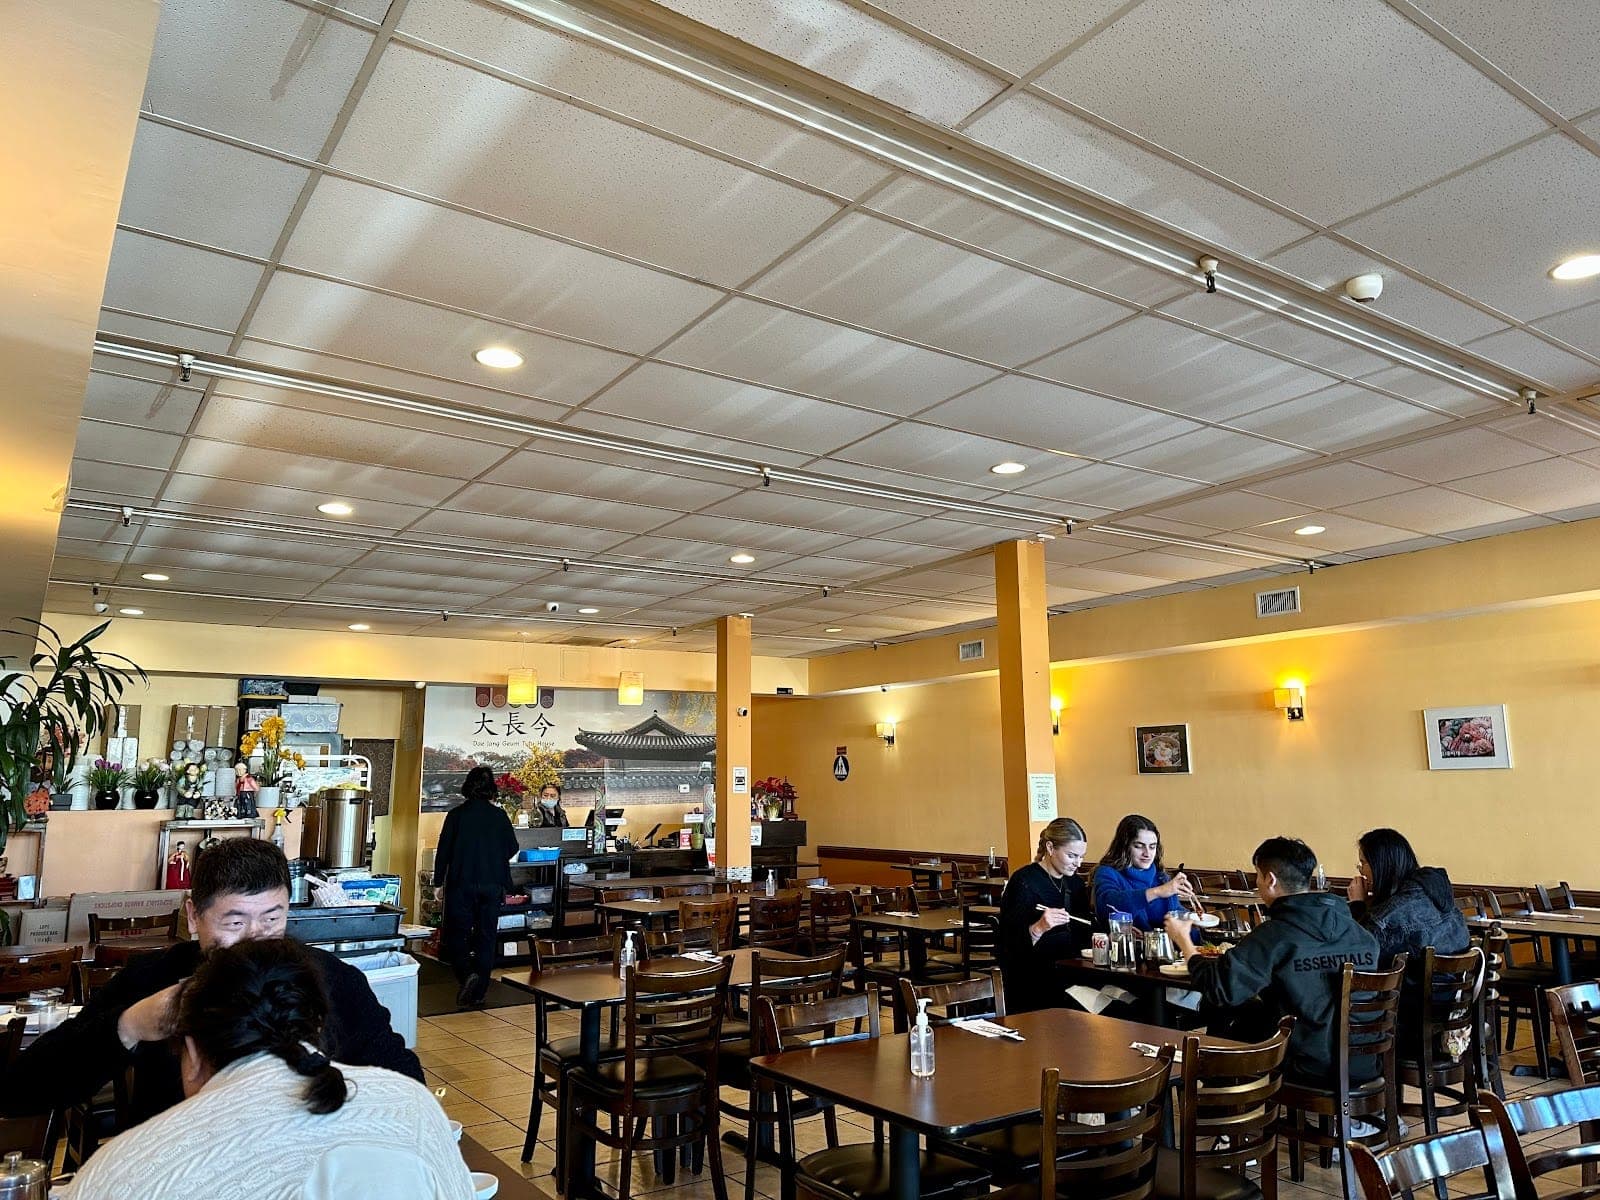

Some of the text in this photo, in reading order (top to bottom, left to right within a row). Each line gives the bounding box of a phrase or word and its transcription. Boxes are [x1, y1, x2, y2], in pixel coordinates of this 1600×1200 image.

[472, 711, 556, 738] 大長今
[1293, 952, 1374, 972] ESSENTIALS
